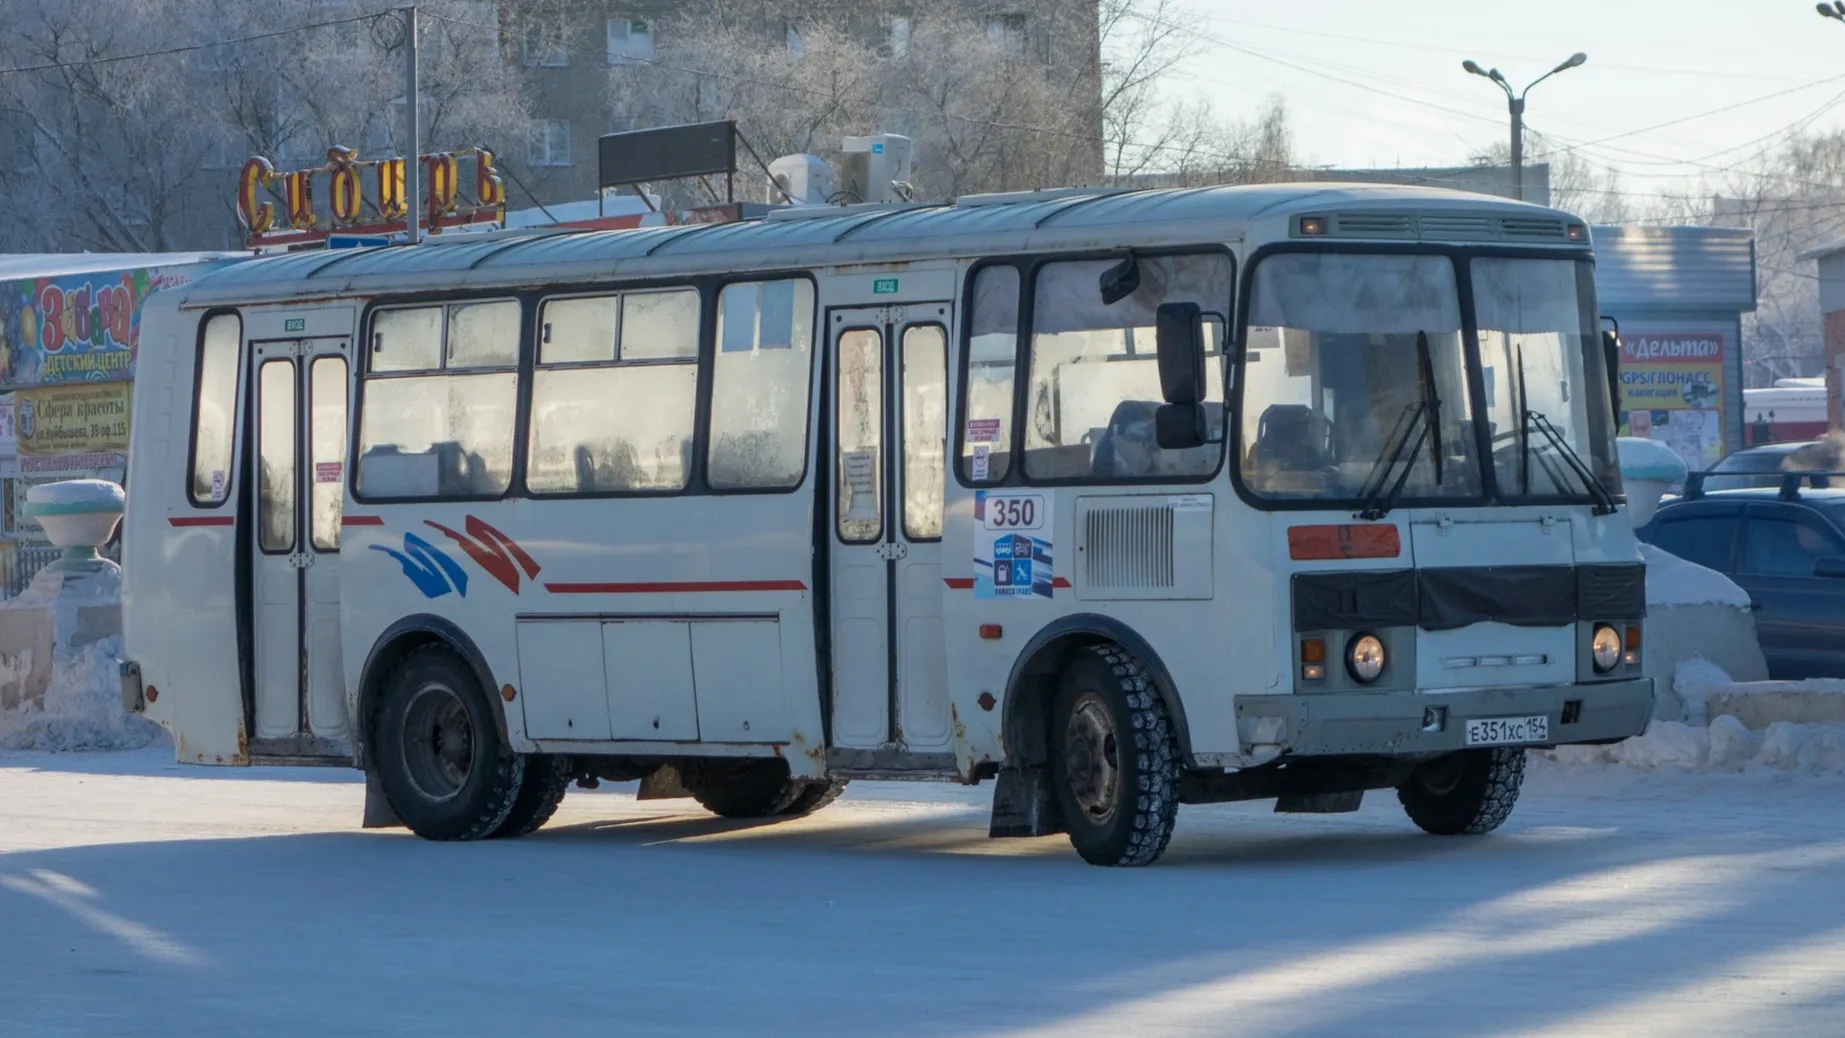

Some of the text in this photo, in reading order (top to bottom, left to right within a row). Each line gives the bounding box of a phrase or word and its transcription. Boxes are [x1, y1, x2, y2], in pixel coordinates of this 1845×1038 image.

[238, 145, 505, 235] Сибирь
[877, 280, 895, 293] ВХОД
[1625, 337, 1719, 360] «Дельта»
[47, 349, 132, 376] ДЕТСКИЙ ЦЕНТР
[1621, 371, 1712, 385] GPS/ГЛОНАСС
[37, 400, 125, 423] Сфера красоты
[993, 498, 1035, 527] 350
[1471, 717, 1546, 742] Е351ХС 154
